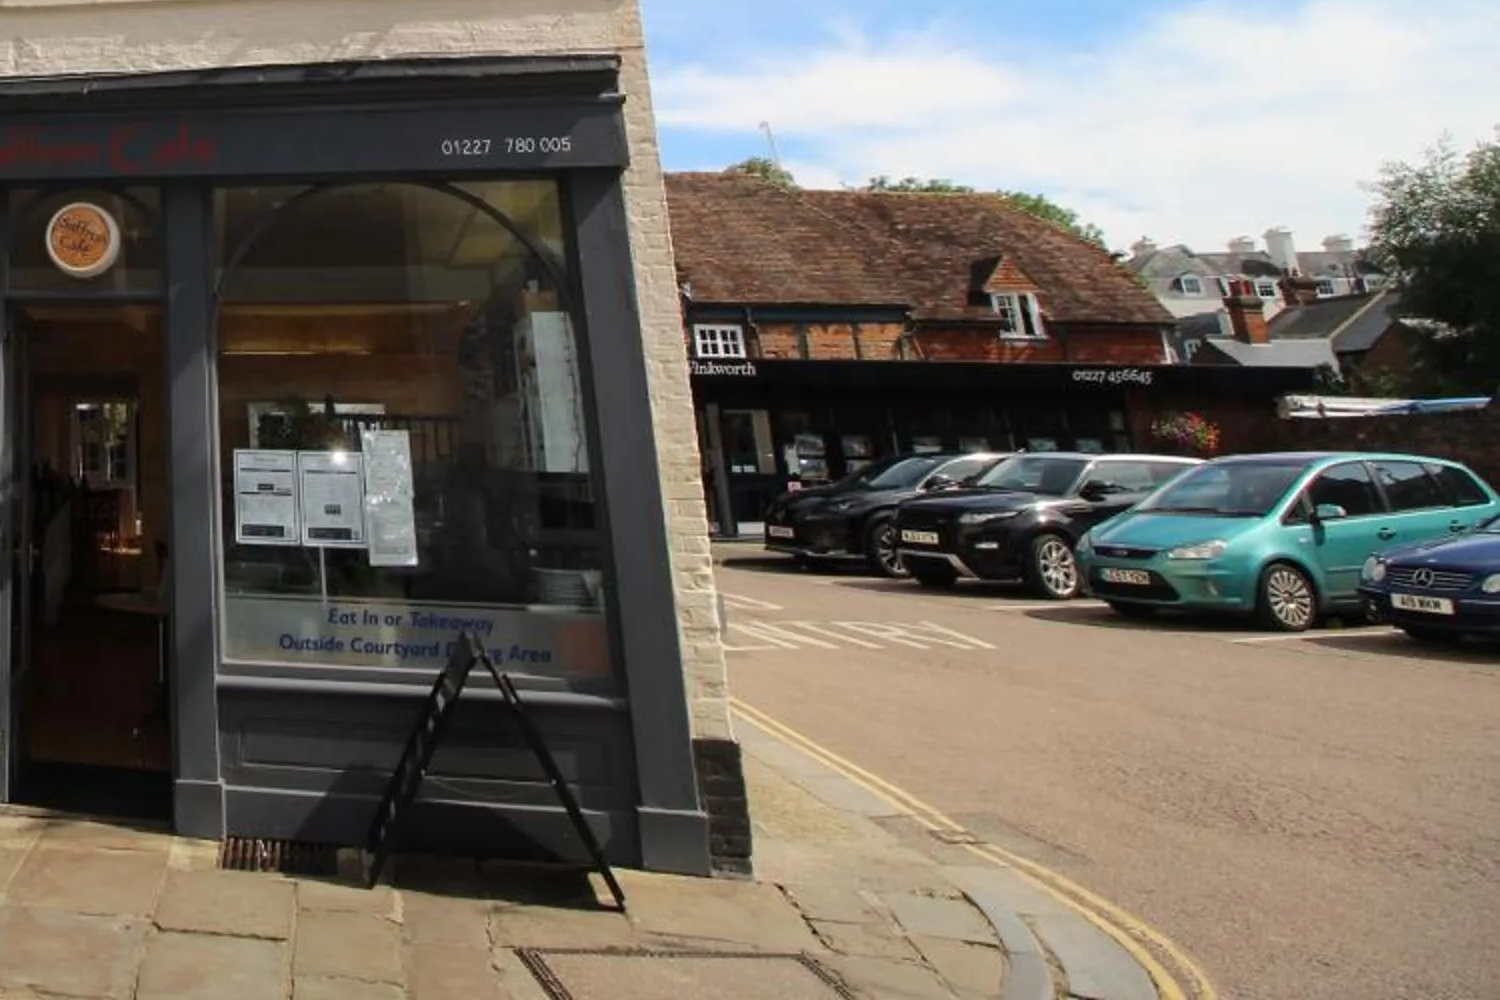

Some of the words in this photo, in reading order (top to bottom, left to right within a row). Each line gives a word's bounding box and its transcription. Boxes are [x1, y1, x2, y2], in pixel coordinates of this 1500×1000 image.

[442, 139, 491, 155] 01227
[505, 137, 535, 153] 780
[539, 136, 572, 152] 005
[691, 361, 757, 376] inkworth
[328, 607, 357, 625] Eat
[363, 609, 379, 625] In
[385, 613, 403, 626] or
[410, 611, 494, 636] Takeaway
[279, 634, 345, 652] Outside
[351, 638, 440, 660] Courtyard
[508, 645, 551, 664] Area
